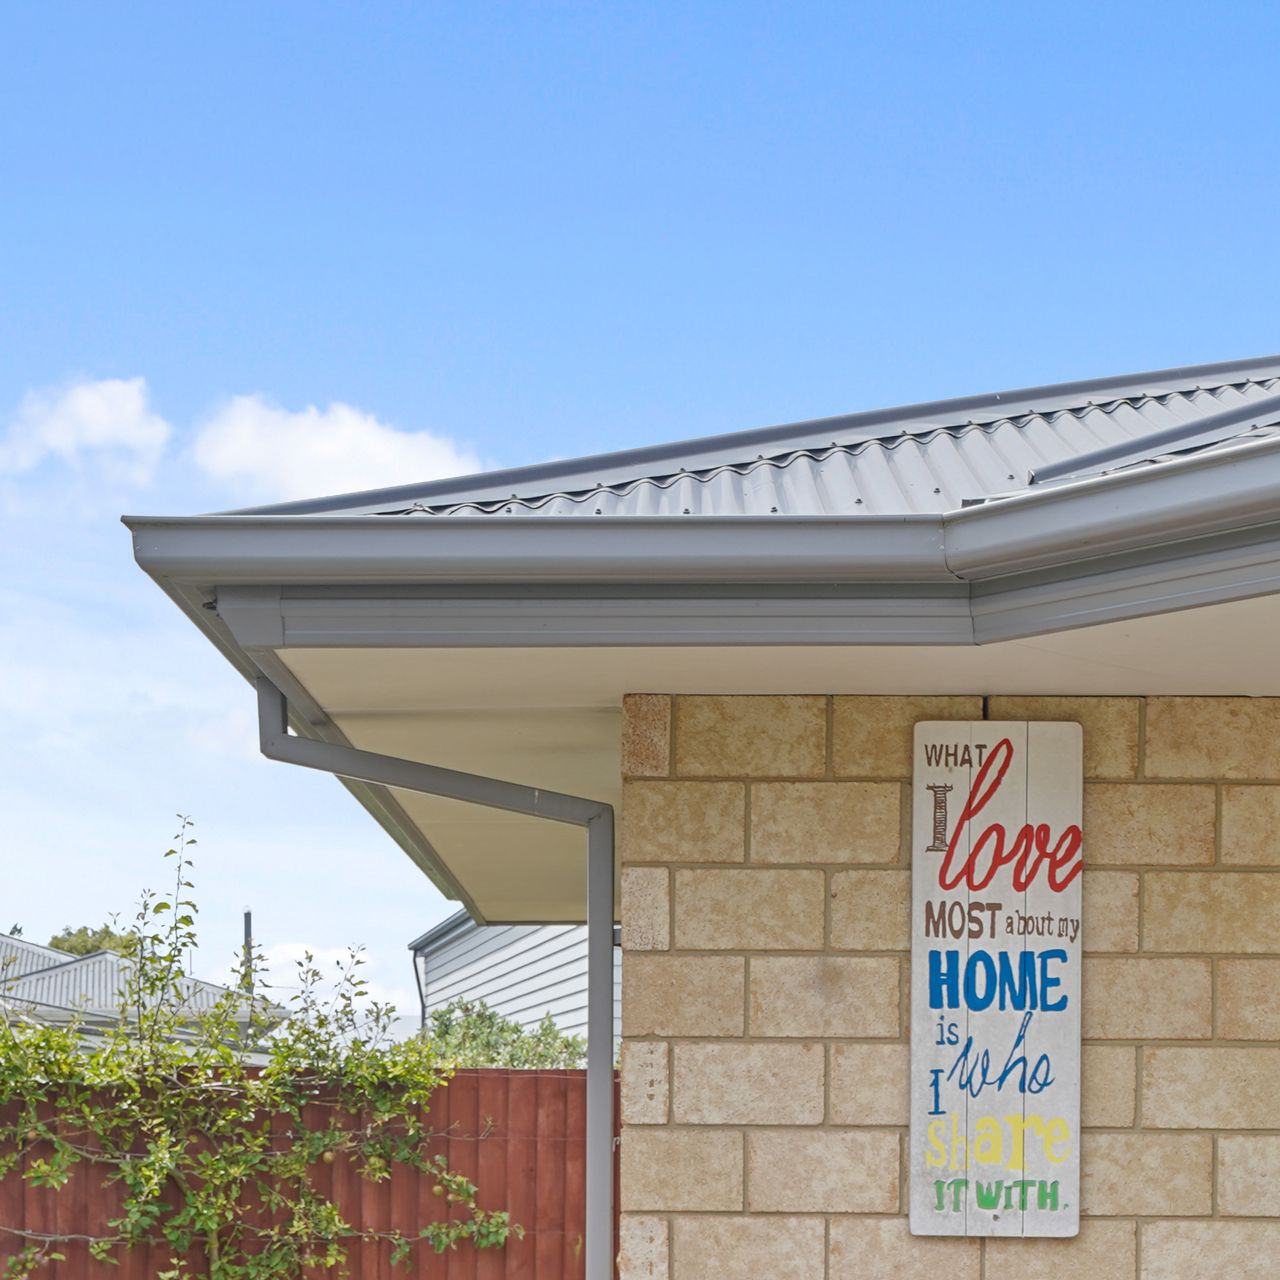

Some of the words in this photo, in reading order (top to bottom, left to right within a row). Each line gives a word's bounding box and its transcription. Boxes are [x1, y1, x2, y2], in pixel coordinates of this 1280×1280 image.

[924, 743, 987, 768] WHAT
[925, 783, 953, 852] I
[938, 738, 1084, 892] love
[924, 900, 1003, 940] MOST
[1005, 910, 1055, 936] about
[1057, 916, 1080, 943] my
[928, 949, 1069, 1012] HOME
[935, 1014, 960, 1046] is
[946, 1010, 1056, 1099] who
[927, 1068, 947, 1116] I
[924, 1112, 1070, 1171] share
[932, 1178, 970, 1213] IT
